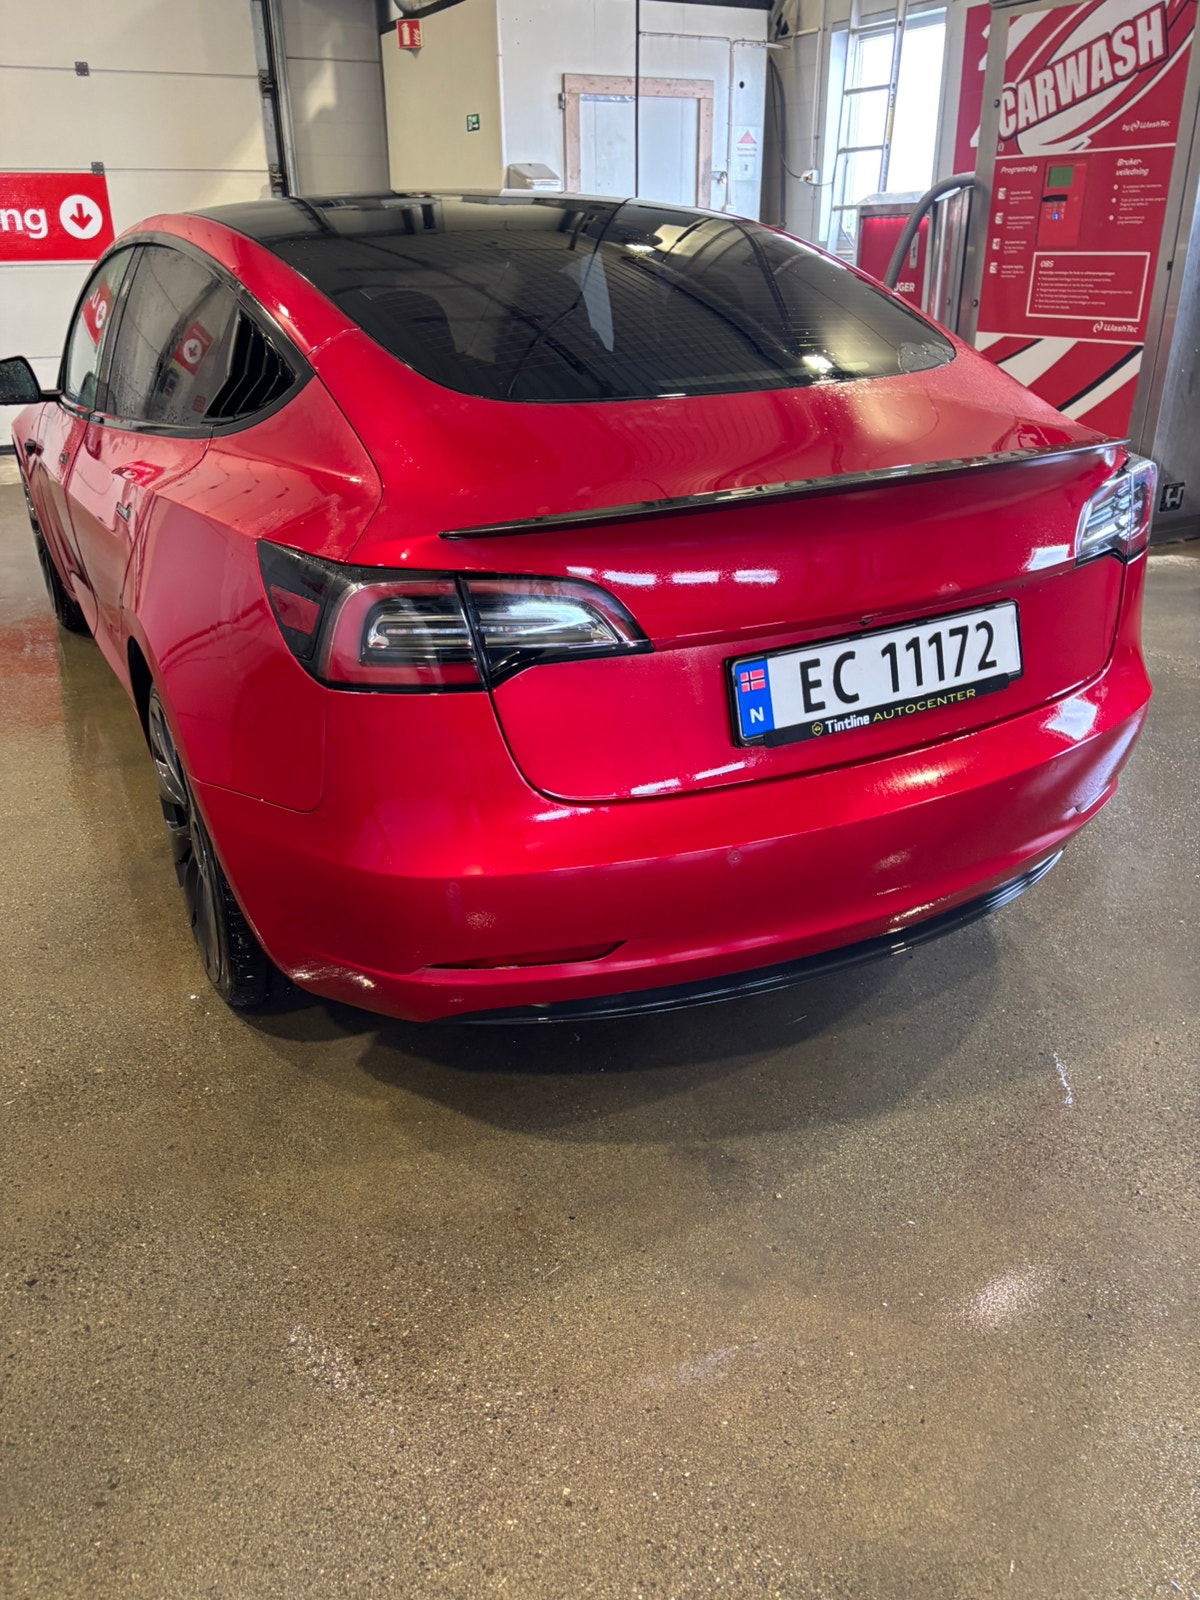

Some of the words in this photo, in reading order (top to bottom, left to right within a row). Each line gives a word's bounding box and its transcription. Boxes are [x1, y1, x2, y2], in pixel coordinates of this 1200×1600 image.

[999, 8, 1164, 137] CARWASH
[1000, 164, 1038, 175] Programvalg
[1103, 323, 1139, 333] WashTec
[799, 650, 860, 714] EC
[880, 620, 997, 693] 11172
[749, 705, 765, 724] N
[825, 714, 870, 734] Tintline
[873, 688, 976, 723] AUTOCENTER
